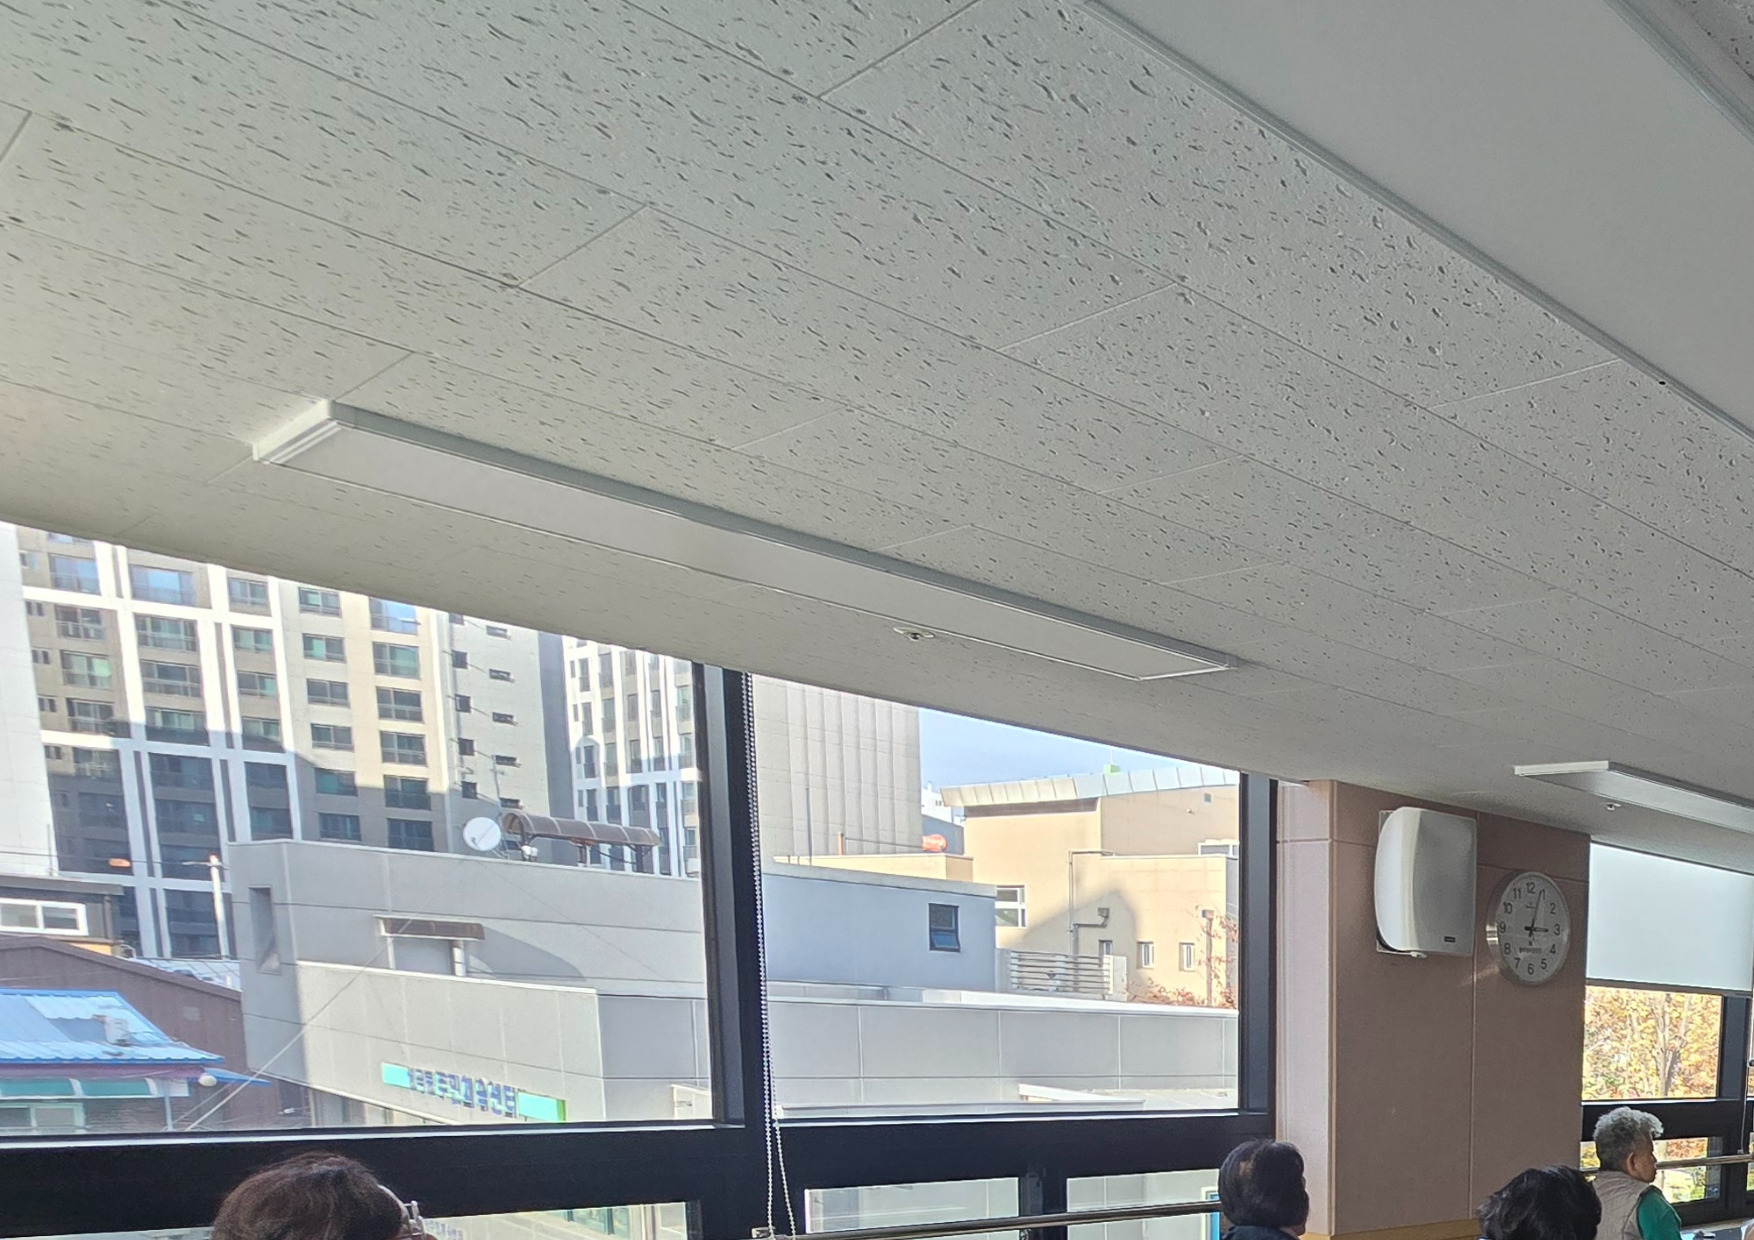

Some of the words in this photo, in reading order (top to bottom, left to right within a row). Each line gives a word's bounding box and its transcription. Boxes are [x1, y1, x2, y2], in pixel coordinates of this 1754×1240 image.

[1514, 888, 1521, 900] 11
[1526, 882, 1536, 894] 12
[1503, 902, 1513, 914] 10
